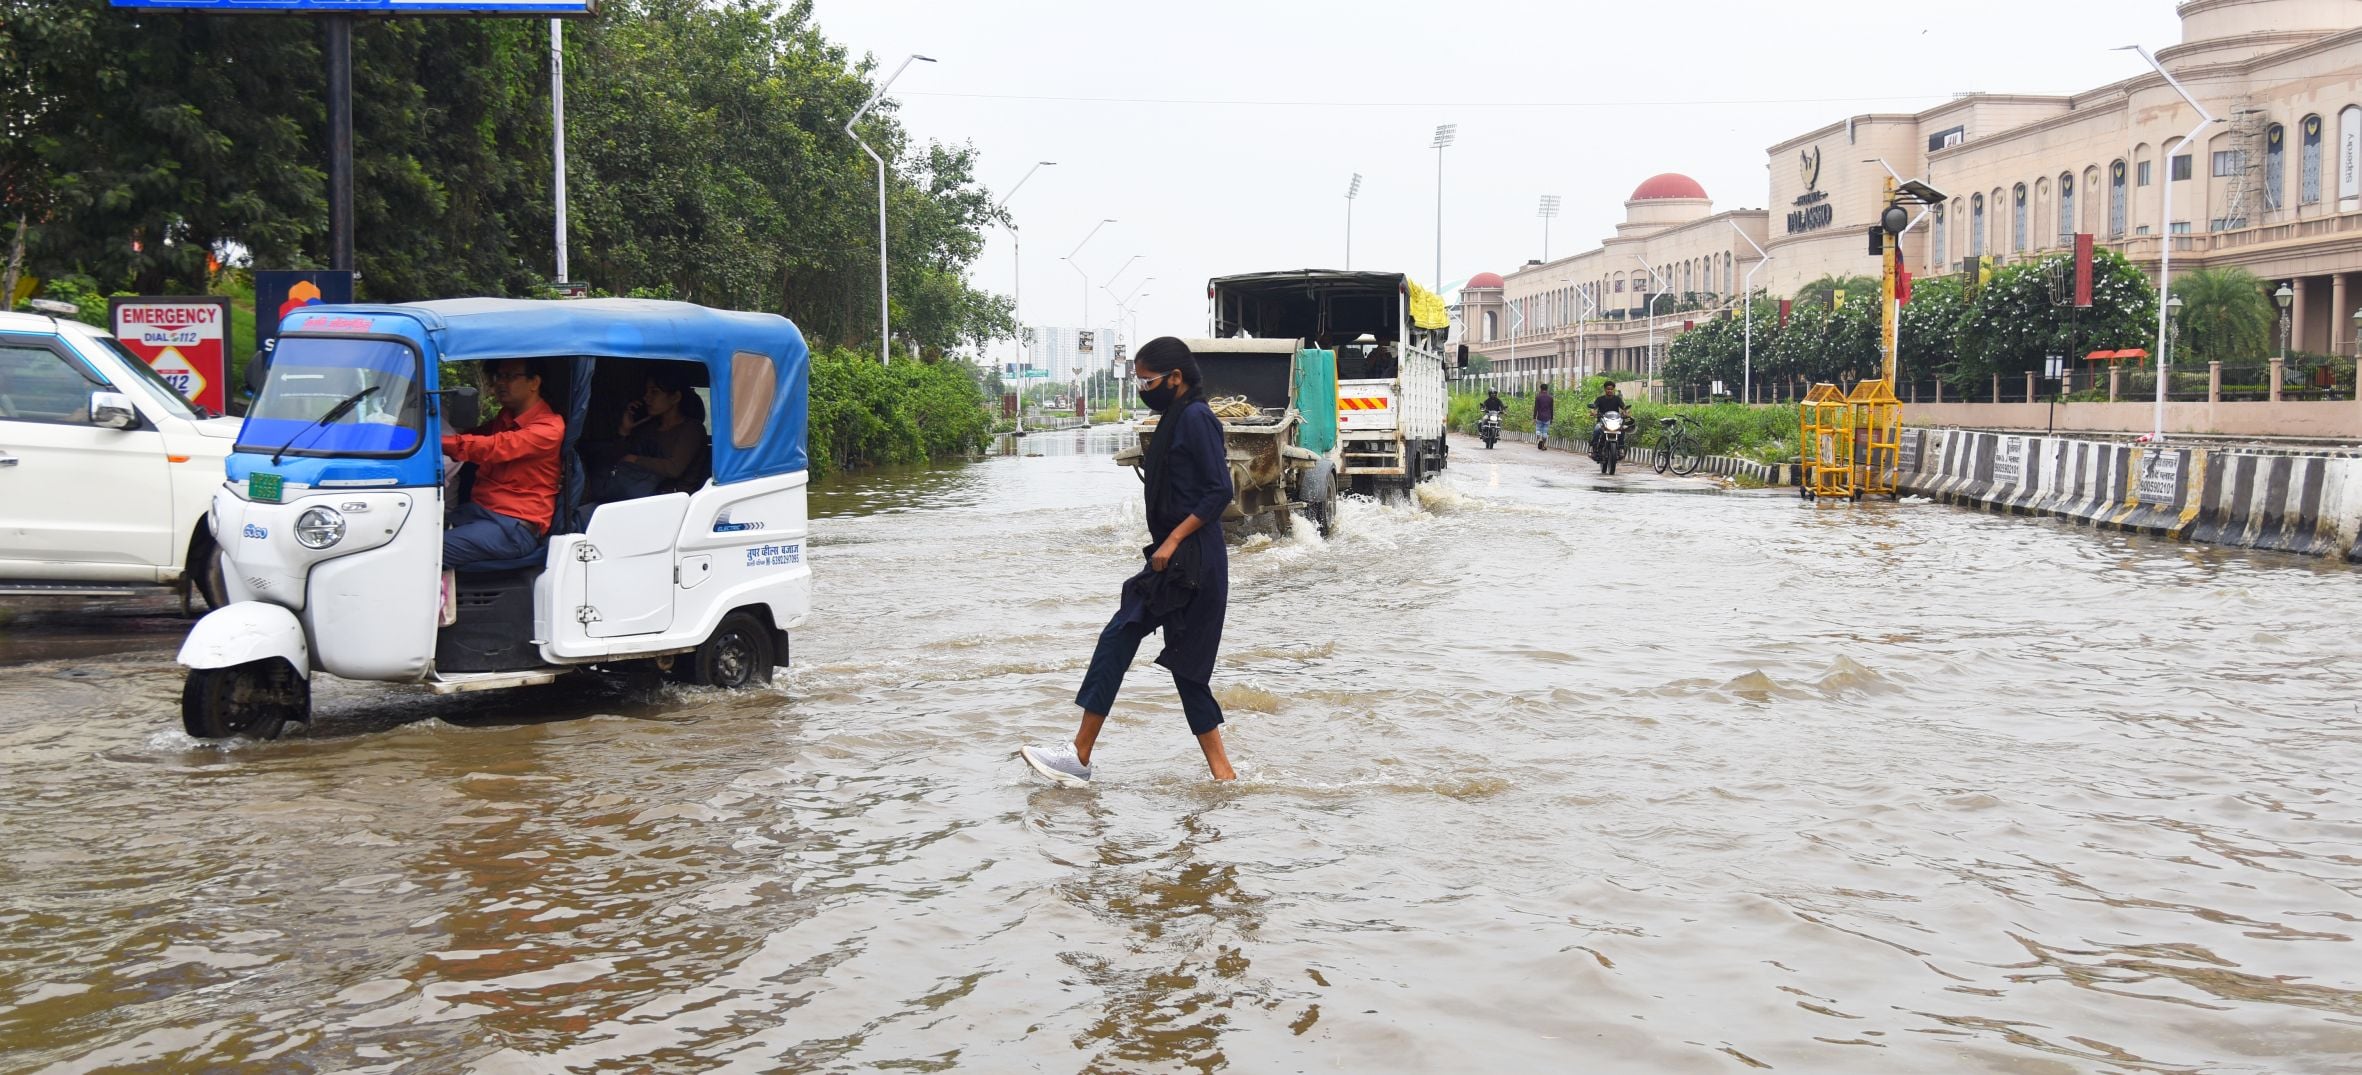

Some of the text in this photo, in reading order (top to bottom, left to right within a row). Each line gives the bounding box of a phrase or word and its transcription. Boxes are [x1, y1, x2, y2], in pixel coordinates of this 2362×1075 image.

[122, 308, 217, 324] EMERGENCY
[144, 332, 197, 342] DIAL 112
[2140, 480, 2174, 494] 9005902101
[781, 544, 799, 554] बजाज
